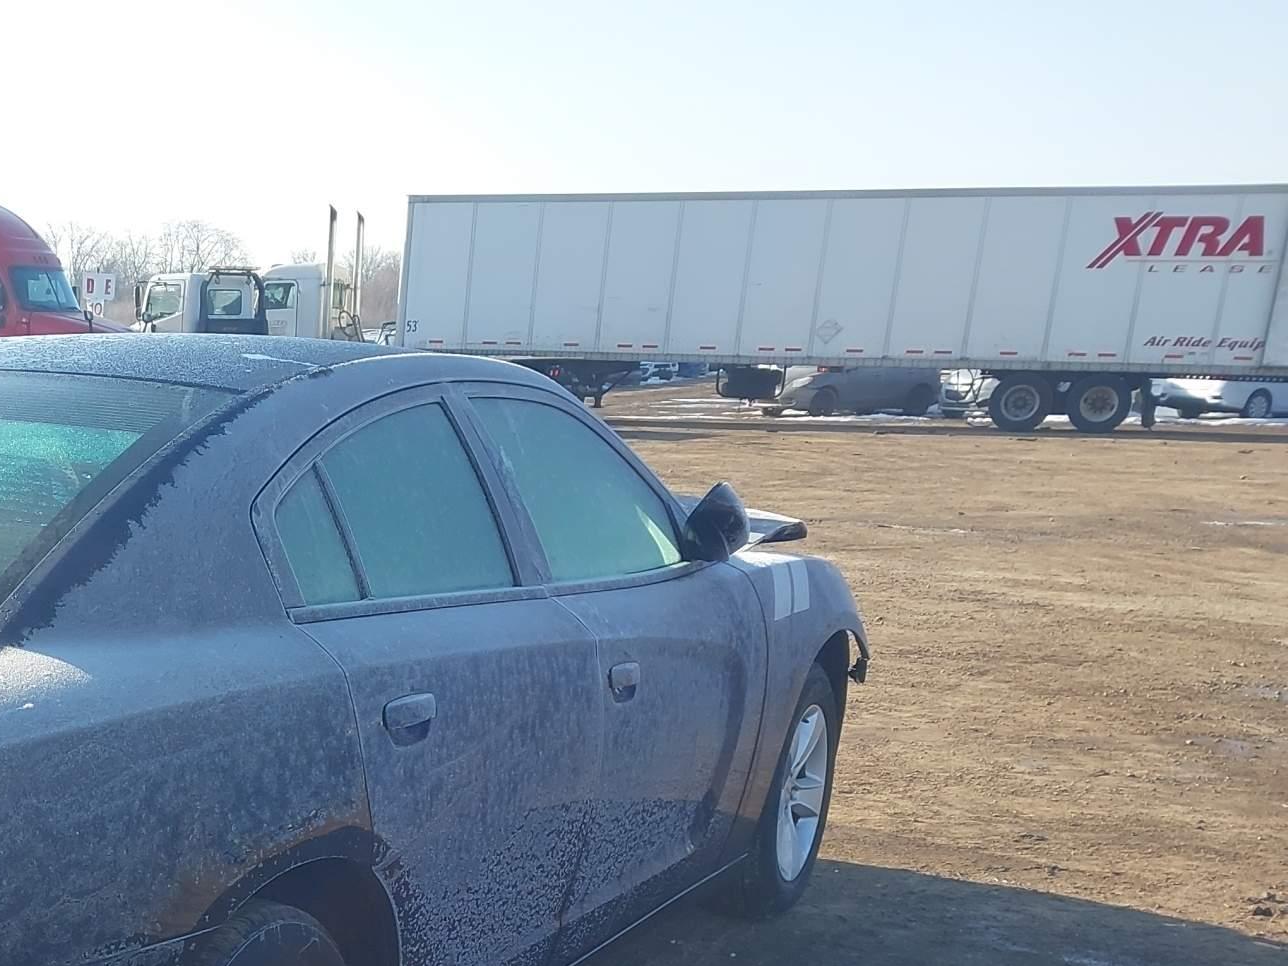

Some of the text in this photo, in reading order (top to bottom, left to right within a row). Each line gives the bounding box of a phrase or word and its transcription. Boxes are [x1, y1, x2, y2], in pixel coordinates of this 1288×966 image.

[1086, 211, 1265, 269] XTRA
[1147, 264, 1274, 274] LEASE
[86, 278, 112, 295] D E
[1143, 336, 1171, 347] Air
[1172, 336, 1212, 348] Ride
